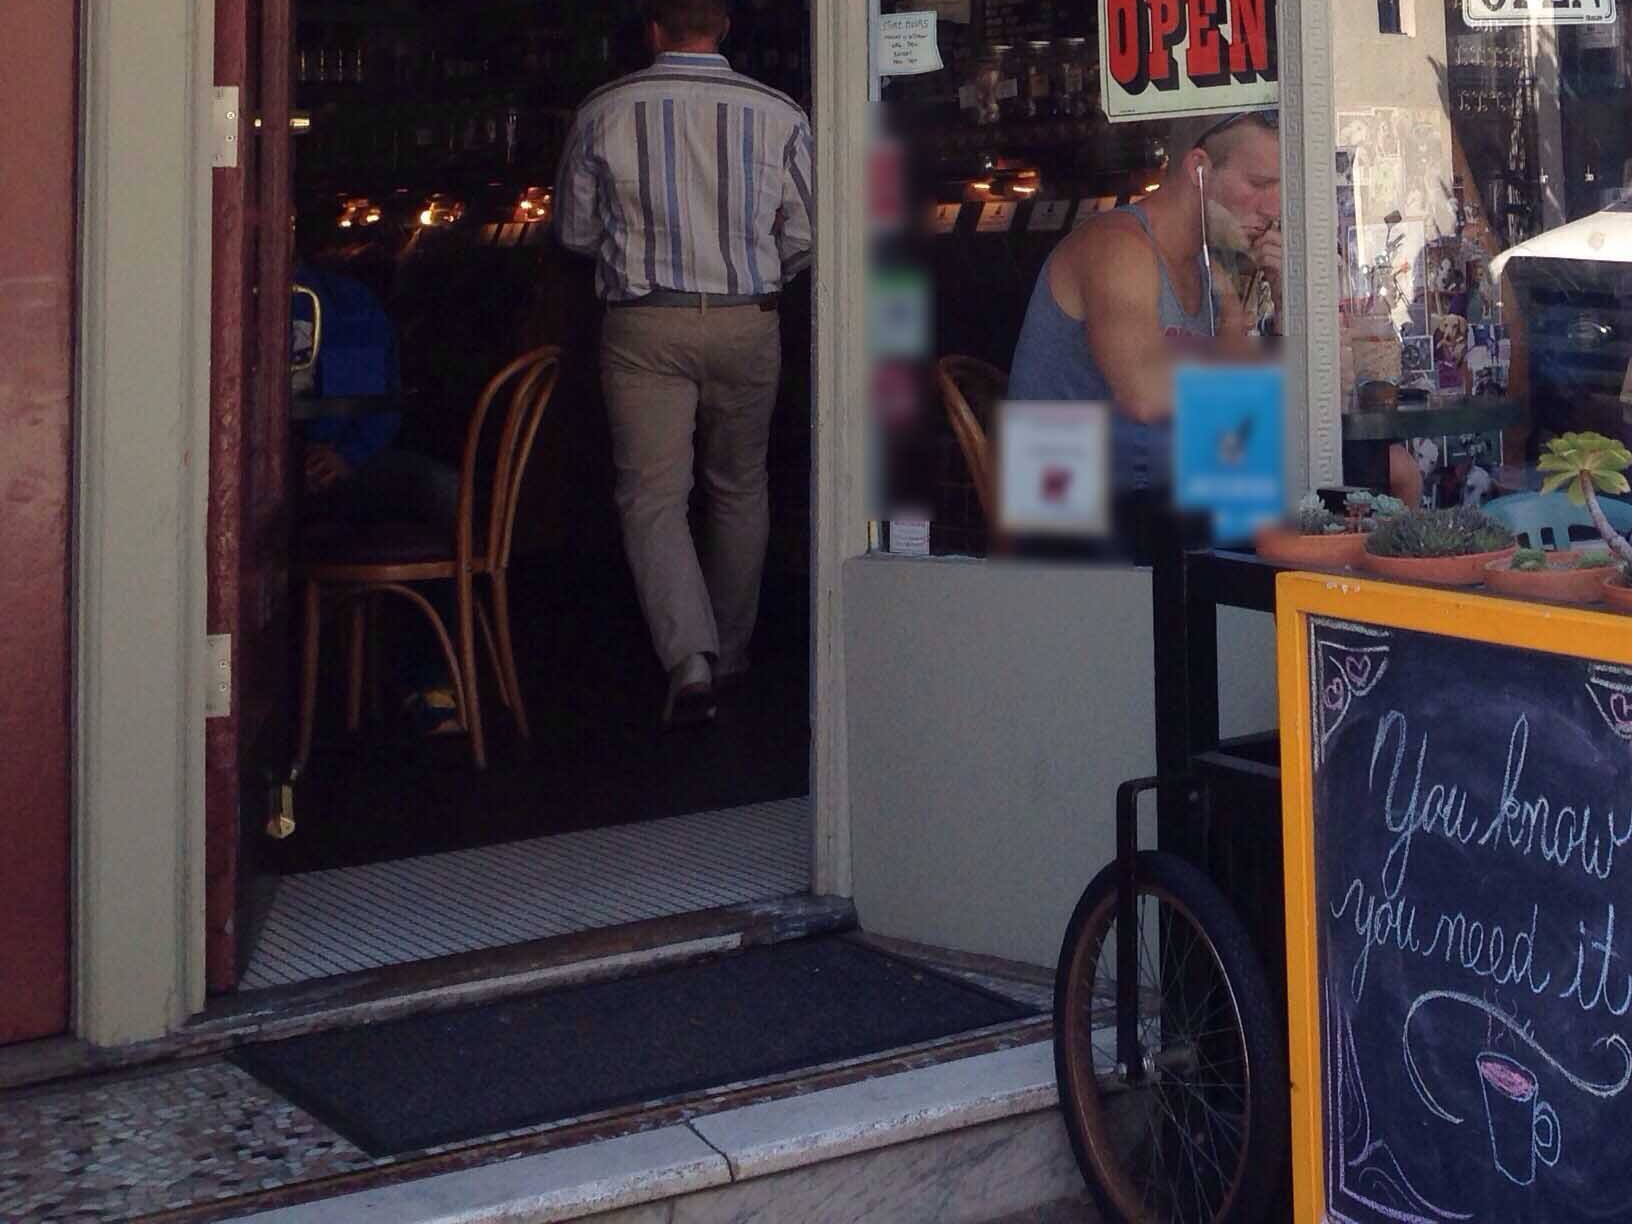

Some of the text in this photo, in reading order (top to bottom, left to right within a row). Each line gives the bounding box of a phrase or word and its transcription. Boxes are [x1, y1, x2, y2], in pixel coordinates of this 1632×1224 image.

[1369, 709, 1479, 899] You
[1330, 879, 1421, 1004] you
[1423, 903, 1550, 994] need
